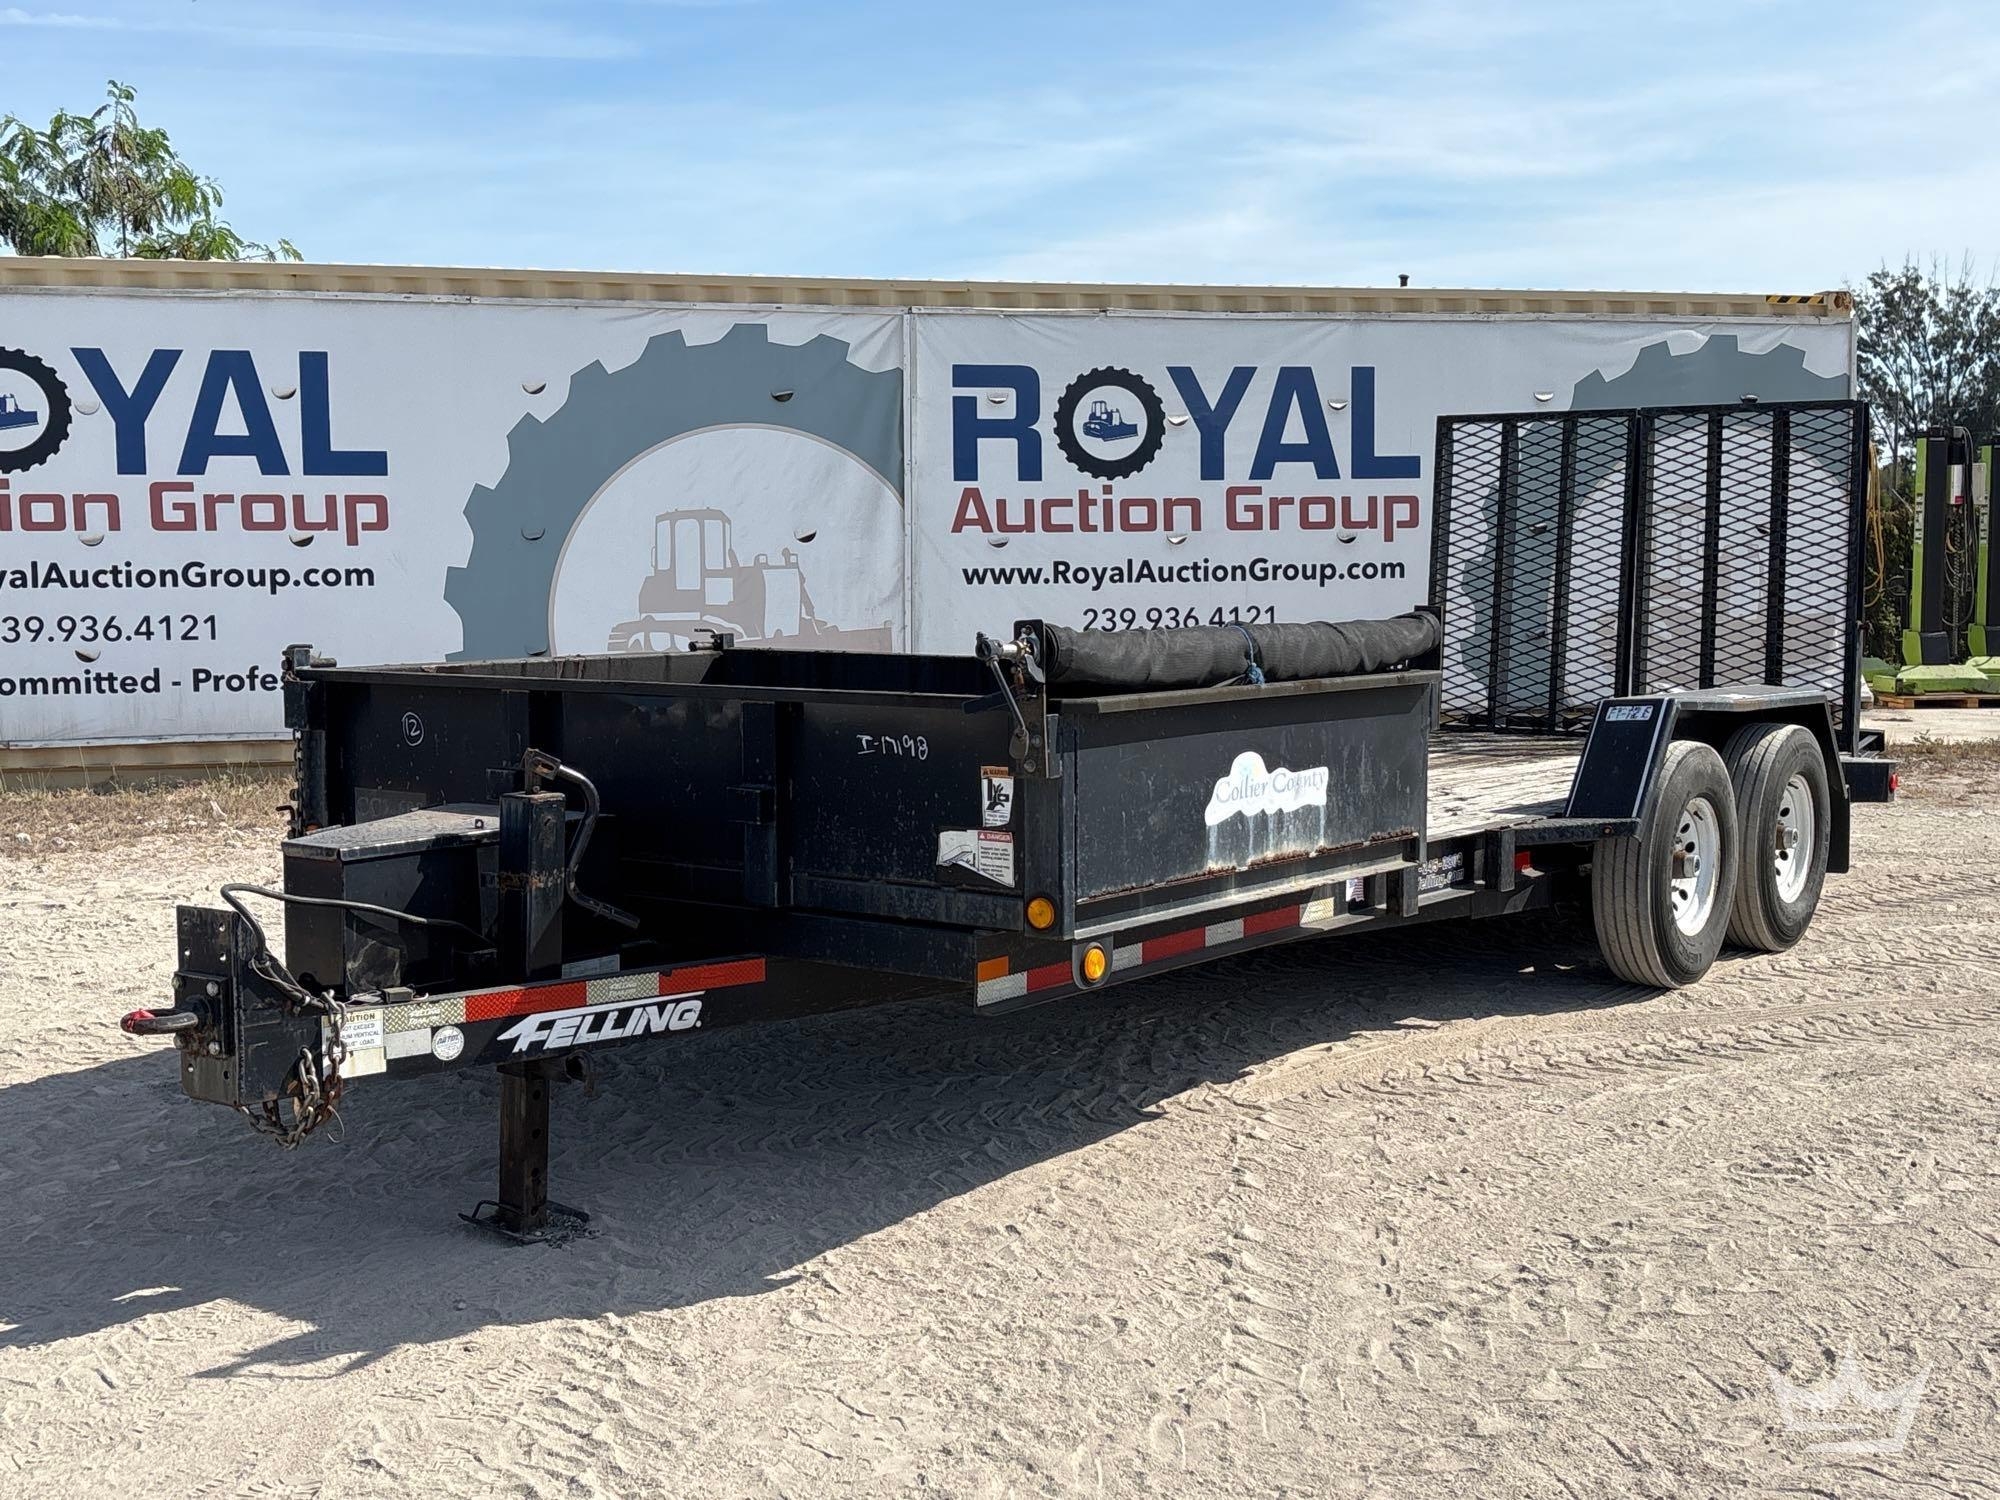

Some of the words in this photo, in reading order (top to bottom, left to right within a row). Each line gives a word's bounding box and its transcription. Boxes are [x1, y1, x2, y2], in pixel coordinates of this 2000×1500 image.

[951, 363, 1421, 482] ROYAL
[149, 481, 390, 546] Group
[951, 485, 1201, 534] Auction
[1225, 486, 1420, 542] Group
[961, 557, 1406, 591] www.RoyalAuctionGroup.com
[192, 665, 283, 692] Profe
[1216, 774, 1269, 803] Collier
[1272, 771, 1326, 794] County
[343, 1012, 376, 1023] AUTION
[497, 991, 706, 1053] FELLING
